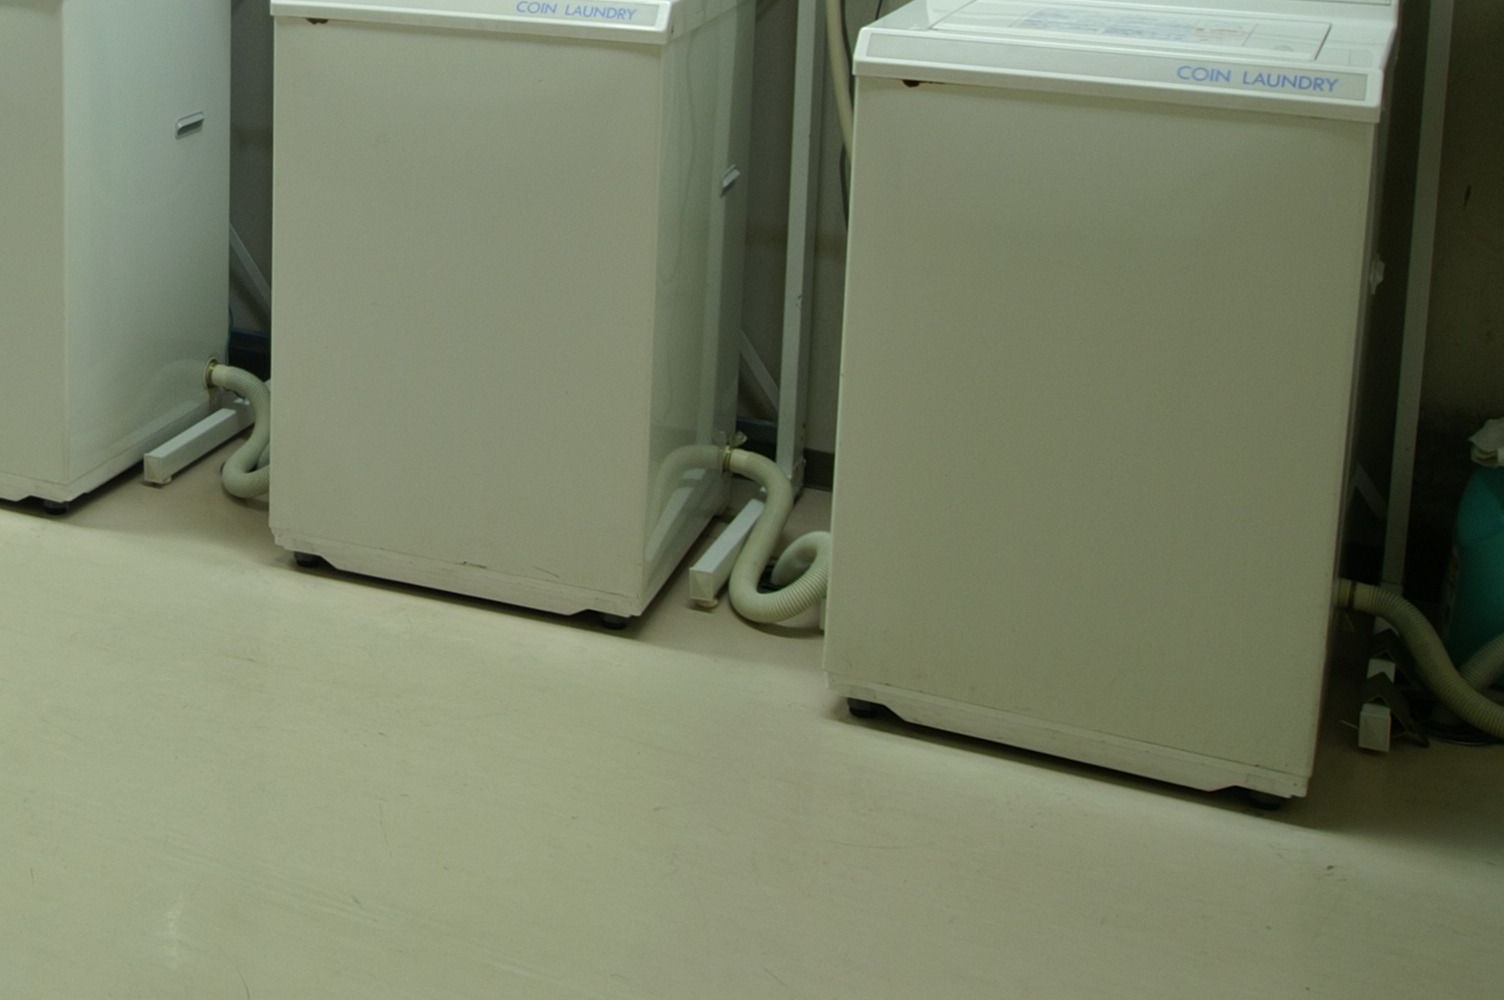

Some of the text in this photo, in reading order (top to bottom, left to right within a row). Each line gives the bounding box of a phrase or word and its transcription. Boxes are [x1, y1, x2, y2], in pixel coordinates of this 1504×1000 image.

[516, 0, 638, 20] COIN LAUNDRY
[1177, 65, 1340, 93] COIN LAUNDRY
